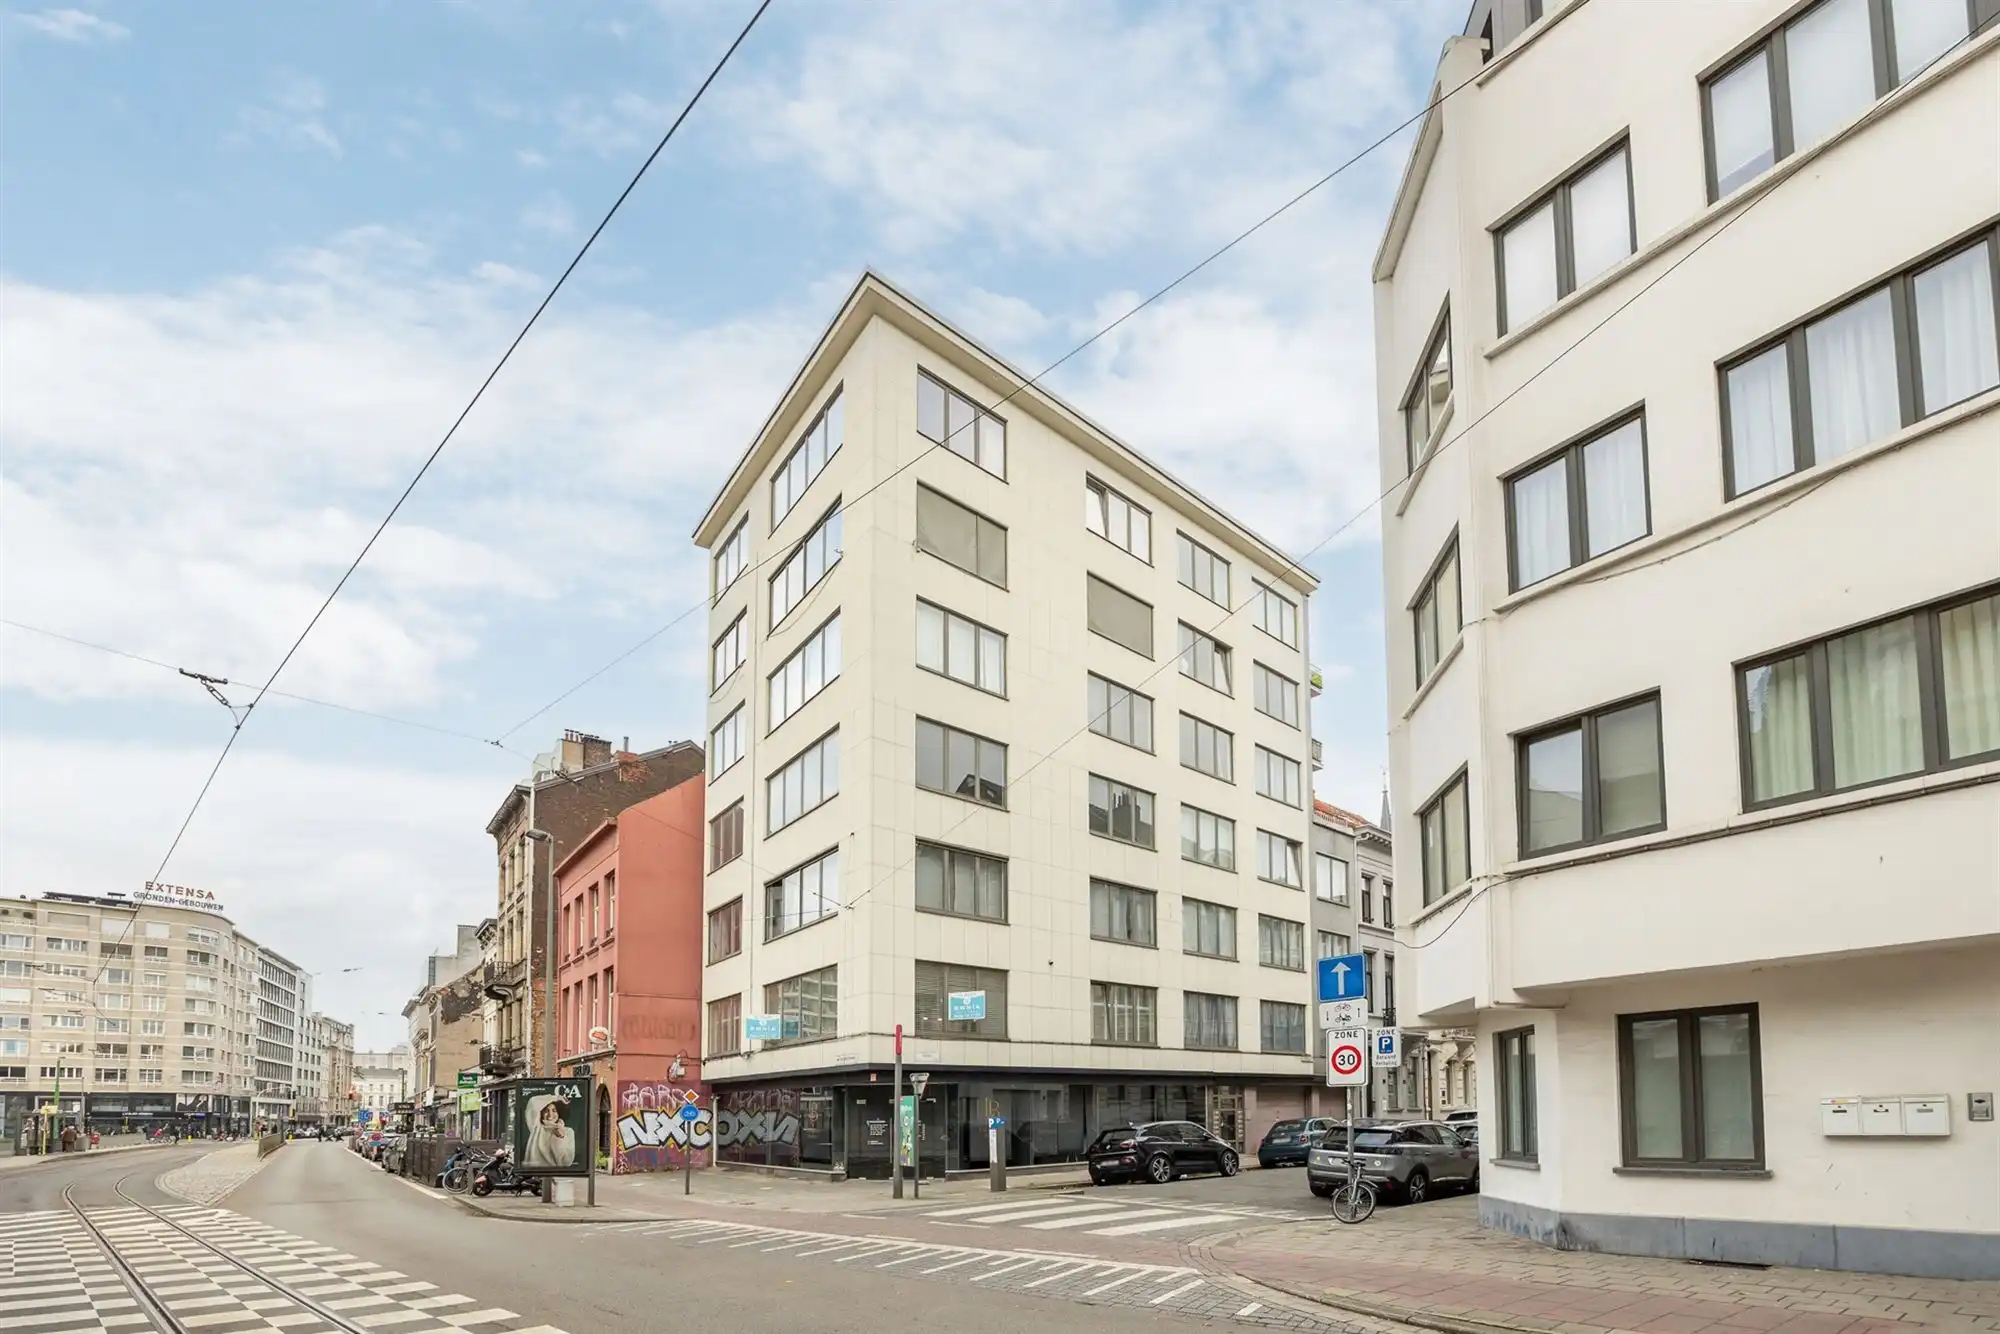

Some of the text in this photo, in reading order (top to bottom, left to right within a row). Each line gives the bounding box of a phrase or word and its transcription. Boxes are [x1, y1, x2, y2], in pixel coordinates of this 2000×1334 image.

[145, 881, 215, 901] EXTENSA
[133, 891, 224, 911] GRONDEN-GEBOUWEN
[1335, 1031, 1358, 1039] ZONE
[1382, 1038, 1391, 1049] P
[1338, 1054, 1355, 1066] 30
[554, 1084, 582, 1098] C&A
